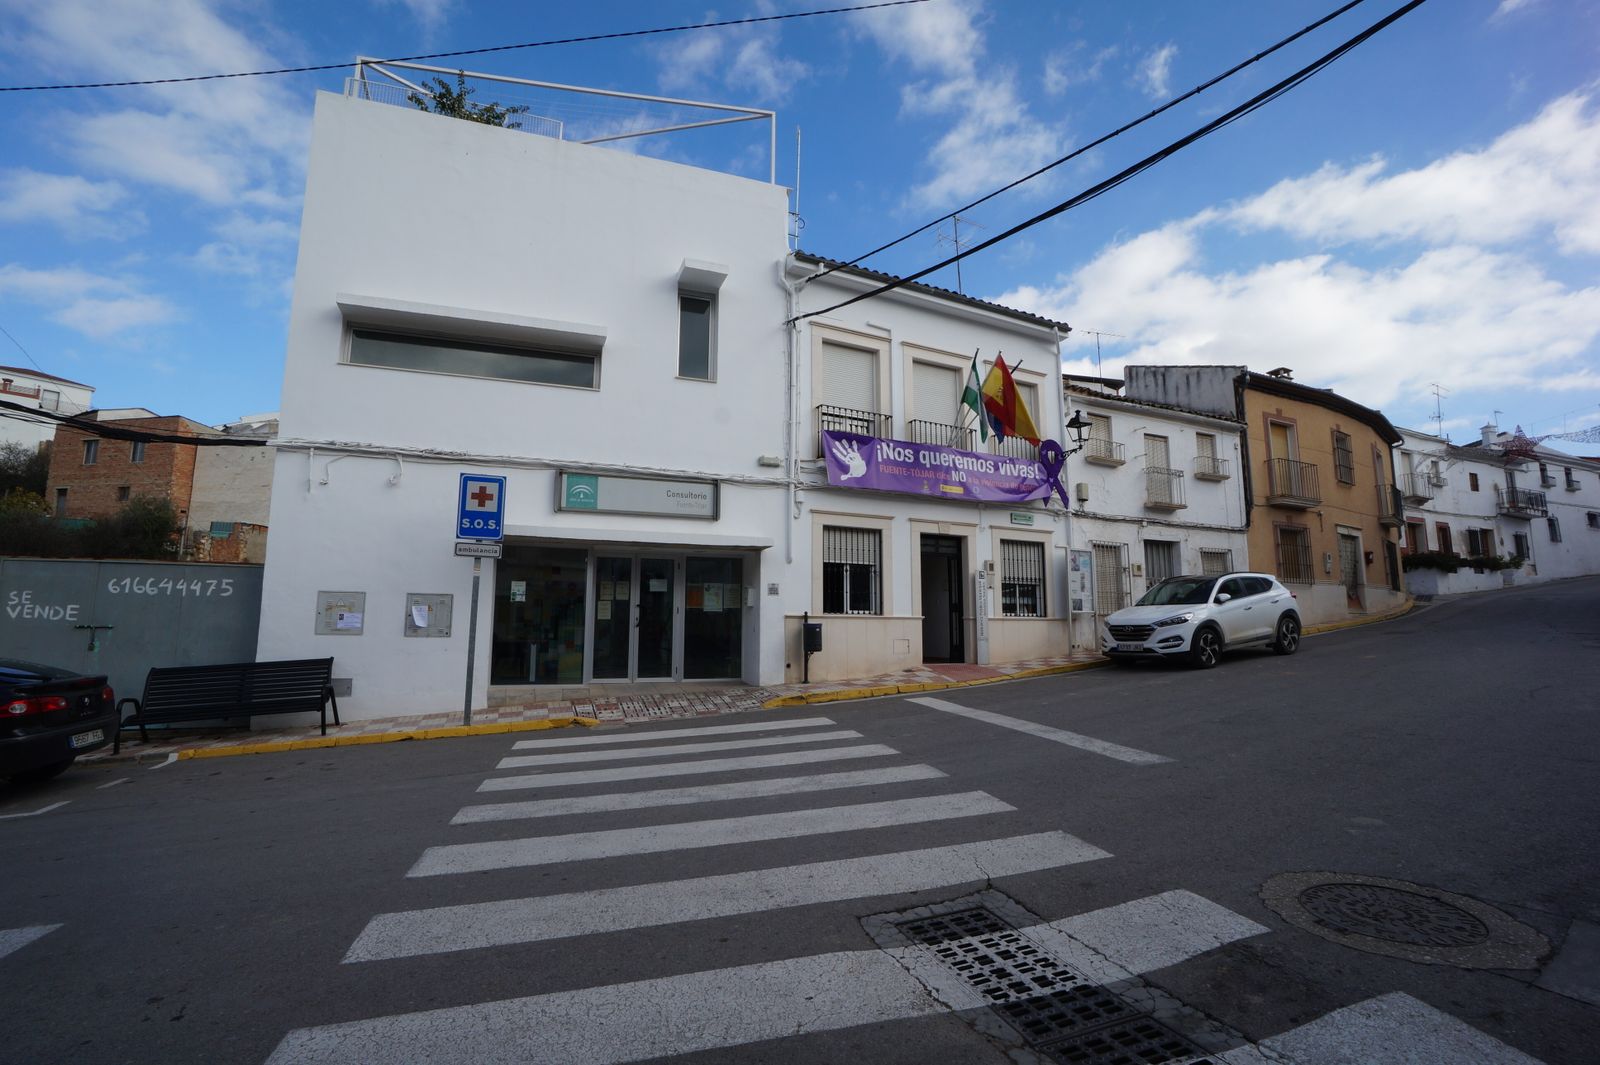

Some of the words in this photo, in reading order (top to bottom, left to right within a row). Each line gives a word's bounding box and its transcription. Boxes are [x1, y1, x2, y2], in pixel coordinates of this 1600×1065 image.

[877, 441, 915, 463] ¡Nos
[919, 450, 995, 474] queremos
[998, 459, 1040, 479] vivas!
[951, 470, 967, 483] NO
[666, 489, 708, 500] Consultorio
[461, 518, 500, 530] S.O.S.
[458, 546, 498, 555] ambulancia
[107, 576, 234, 597] 616644475
[7, 590, 33, 604] SE
[6, 604, 81, 621] VENDE
